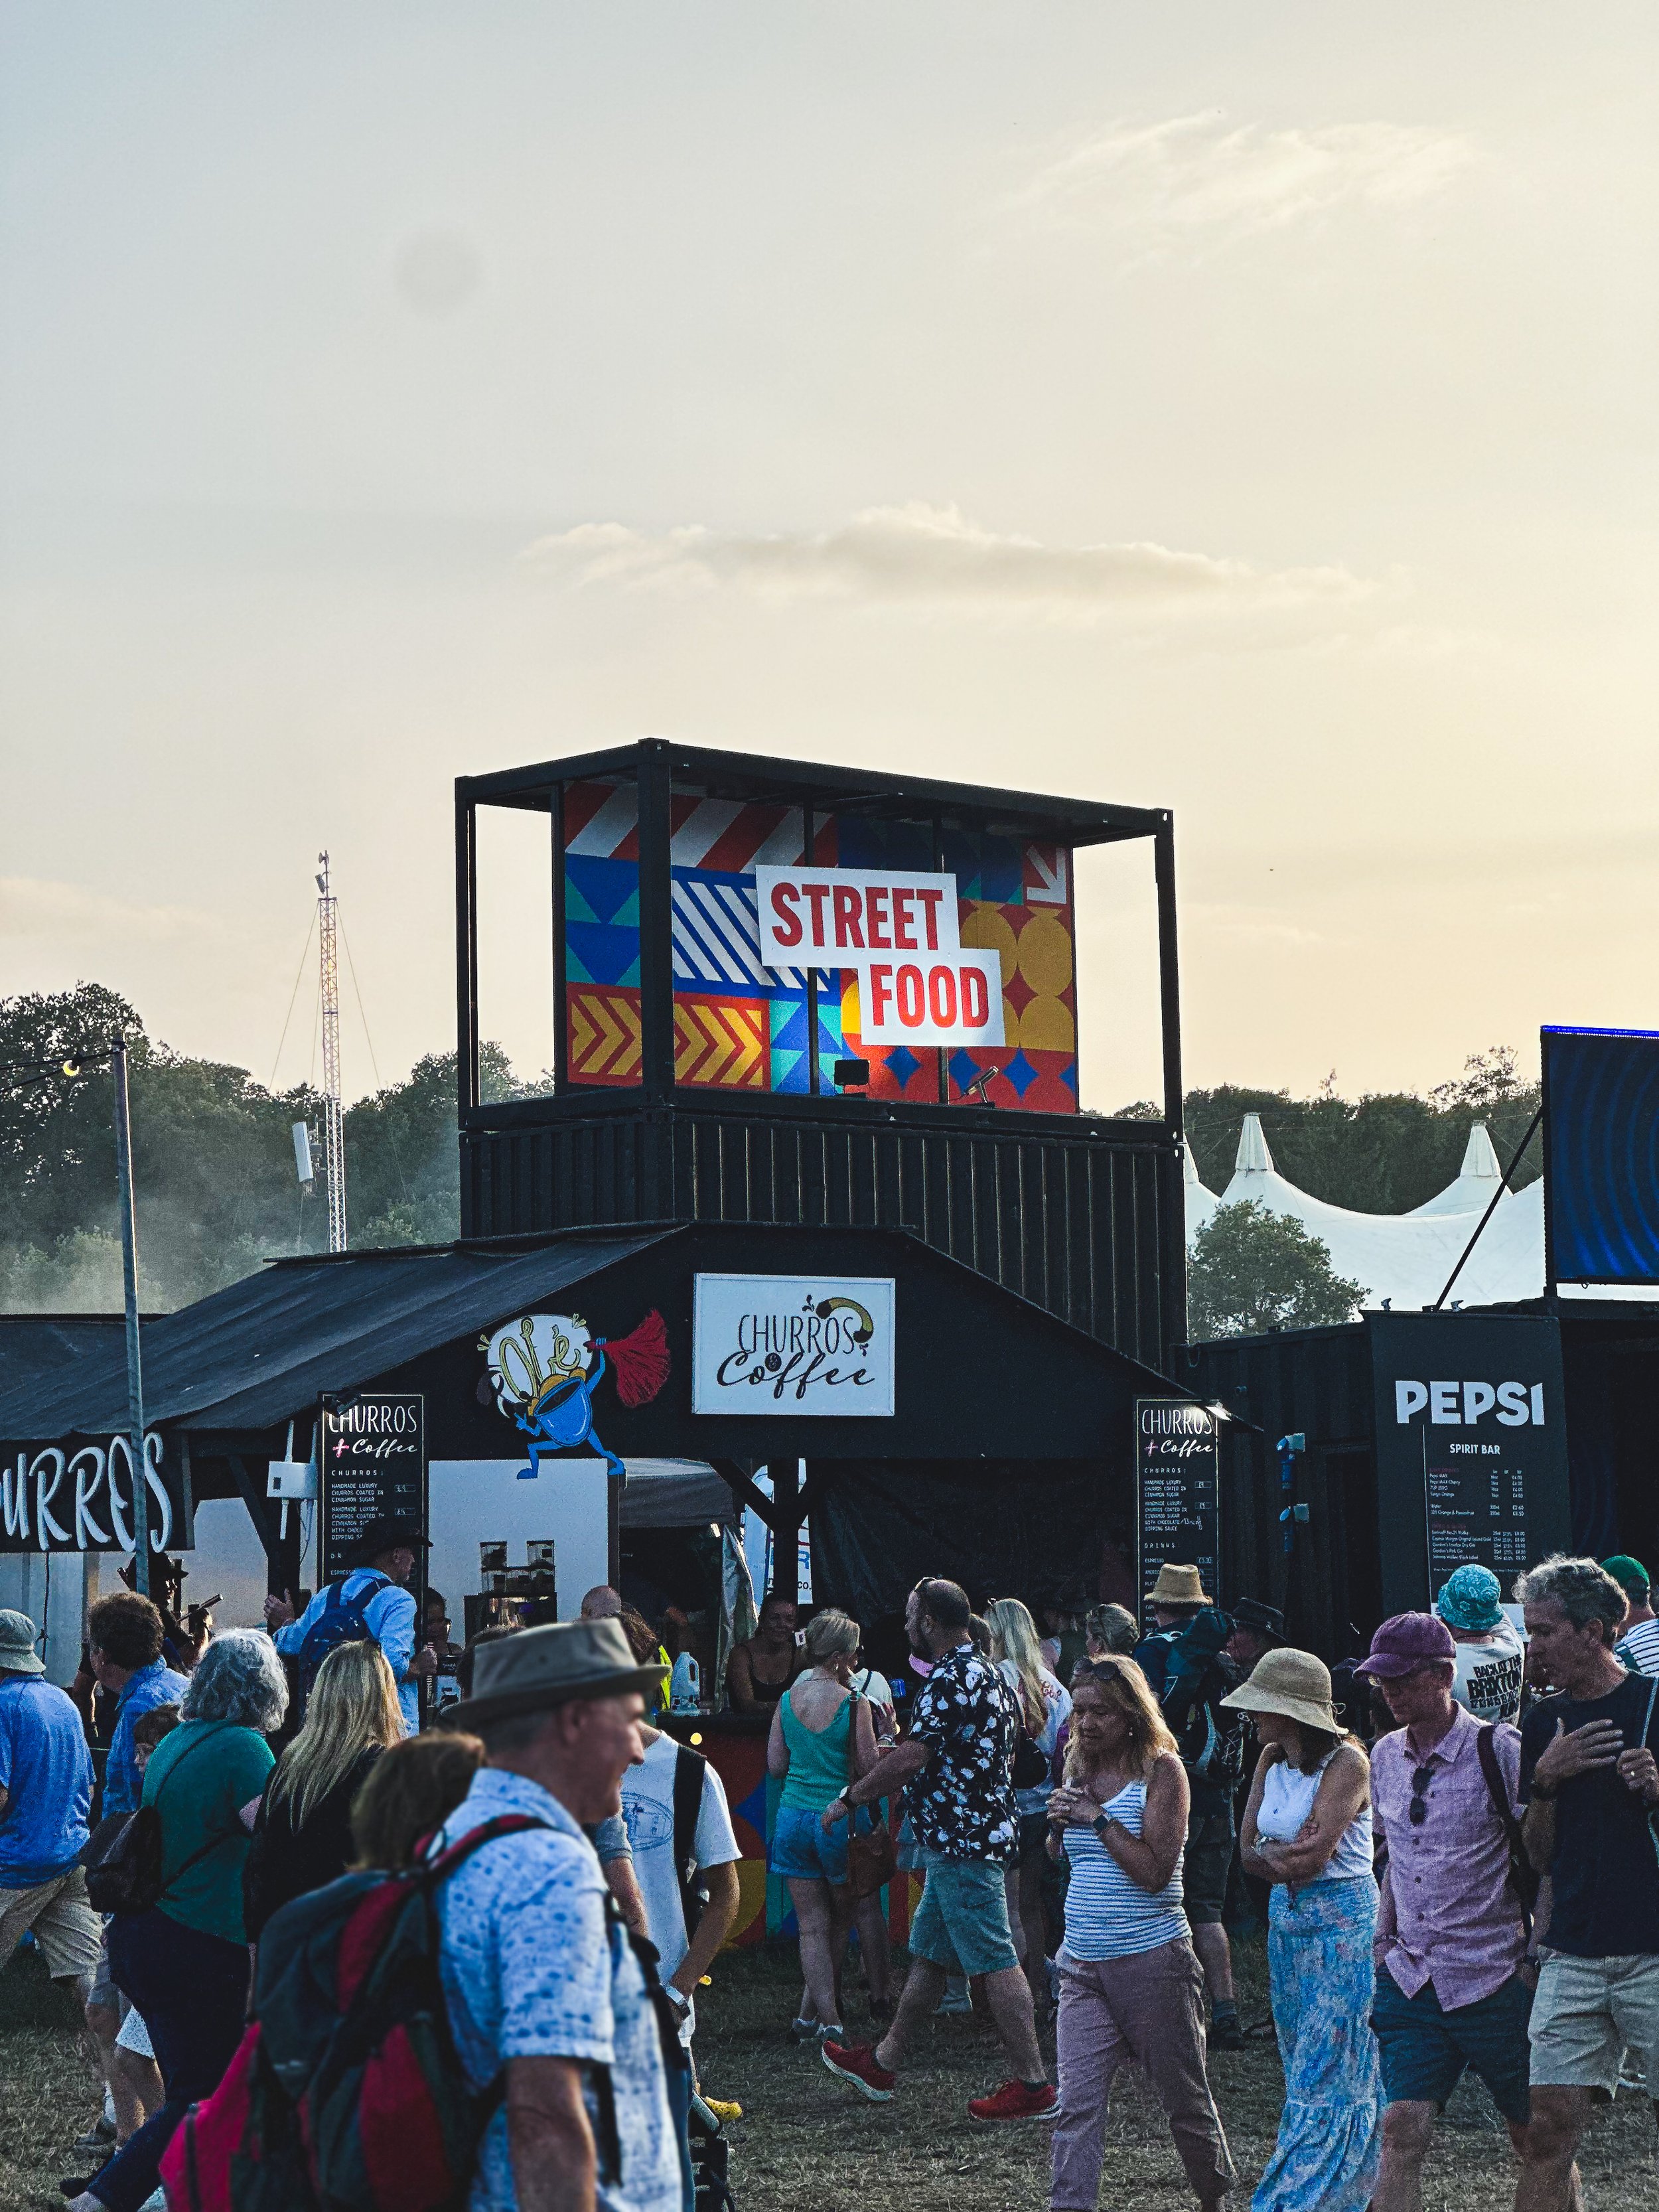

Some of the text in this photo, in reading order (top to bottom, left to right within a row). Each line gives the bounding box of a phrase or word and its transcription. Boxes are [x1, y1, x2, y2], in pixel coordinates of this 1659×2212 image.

[770, 881, 943, 950] STREET
[869, 964, 989, 1028] FOOD
[739, 1314, 855, 1355] CHURROS
[717, 1351, 875, 1400] Coffee
[328, 1405, 417, 1433] CHURROS
[1395, 1380, 1545, 1426] PEPSI
[1142, 1409, 1212, 1435] CHURROS
[352, 1438, 417, 1458] Coffee
[1161, 1439, 1213, 1457] Coffee
[1449, 1443, 1500, 1455] SPIRIT BAR
[0, 1432, 173, 1554] URROS
[1466, 1666, 1523, 1700] BRIXTON
[1473, 1662, 1498, 1678] BACK
[1497, 1659, 1508, 1673] AT
